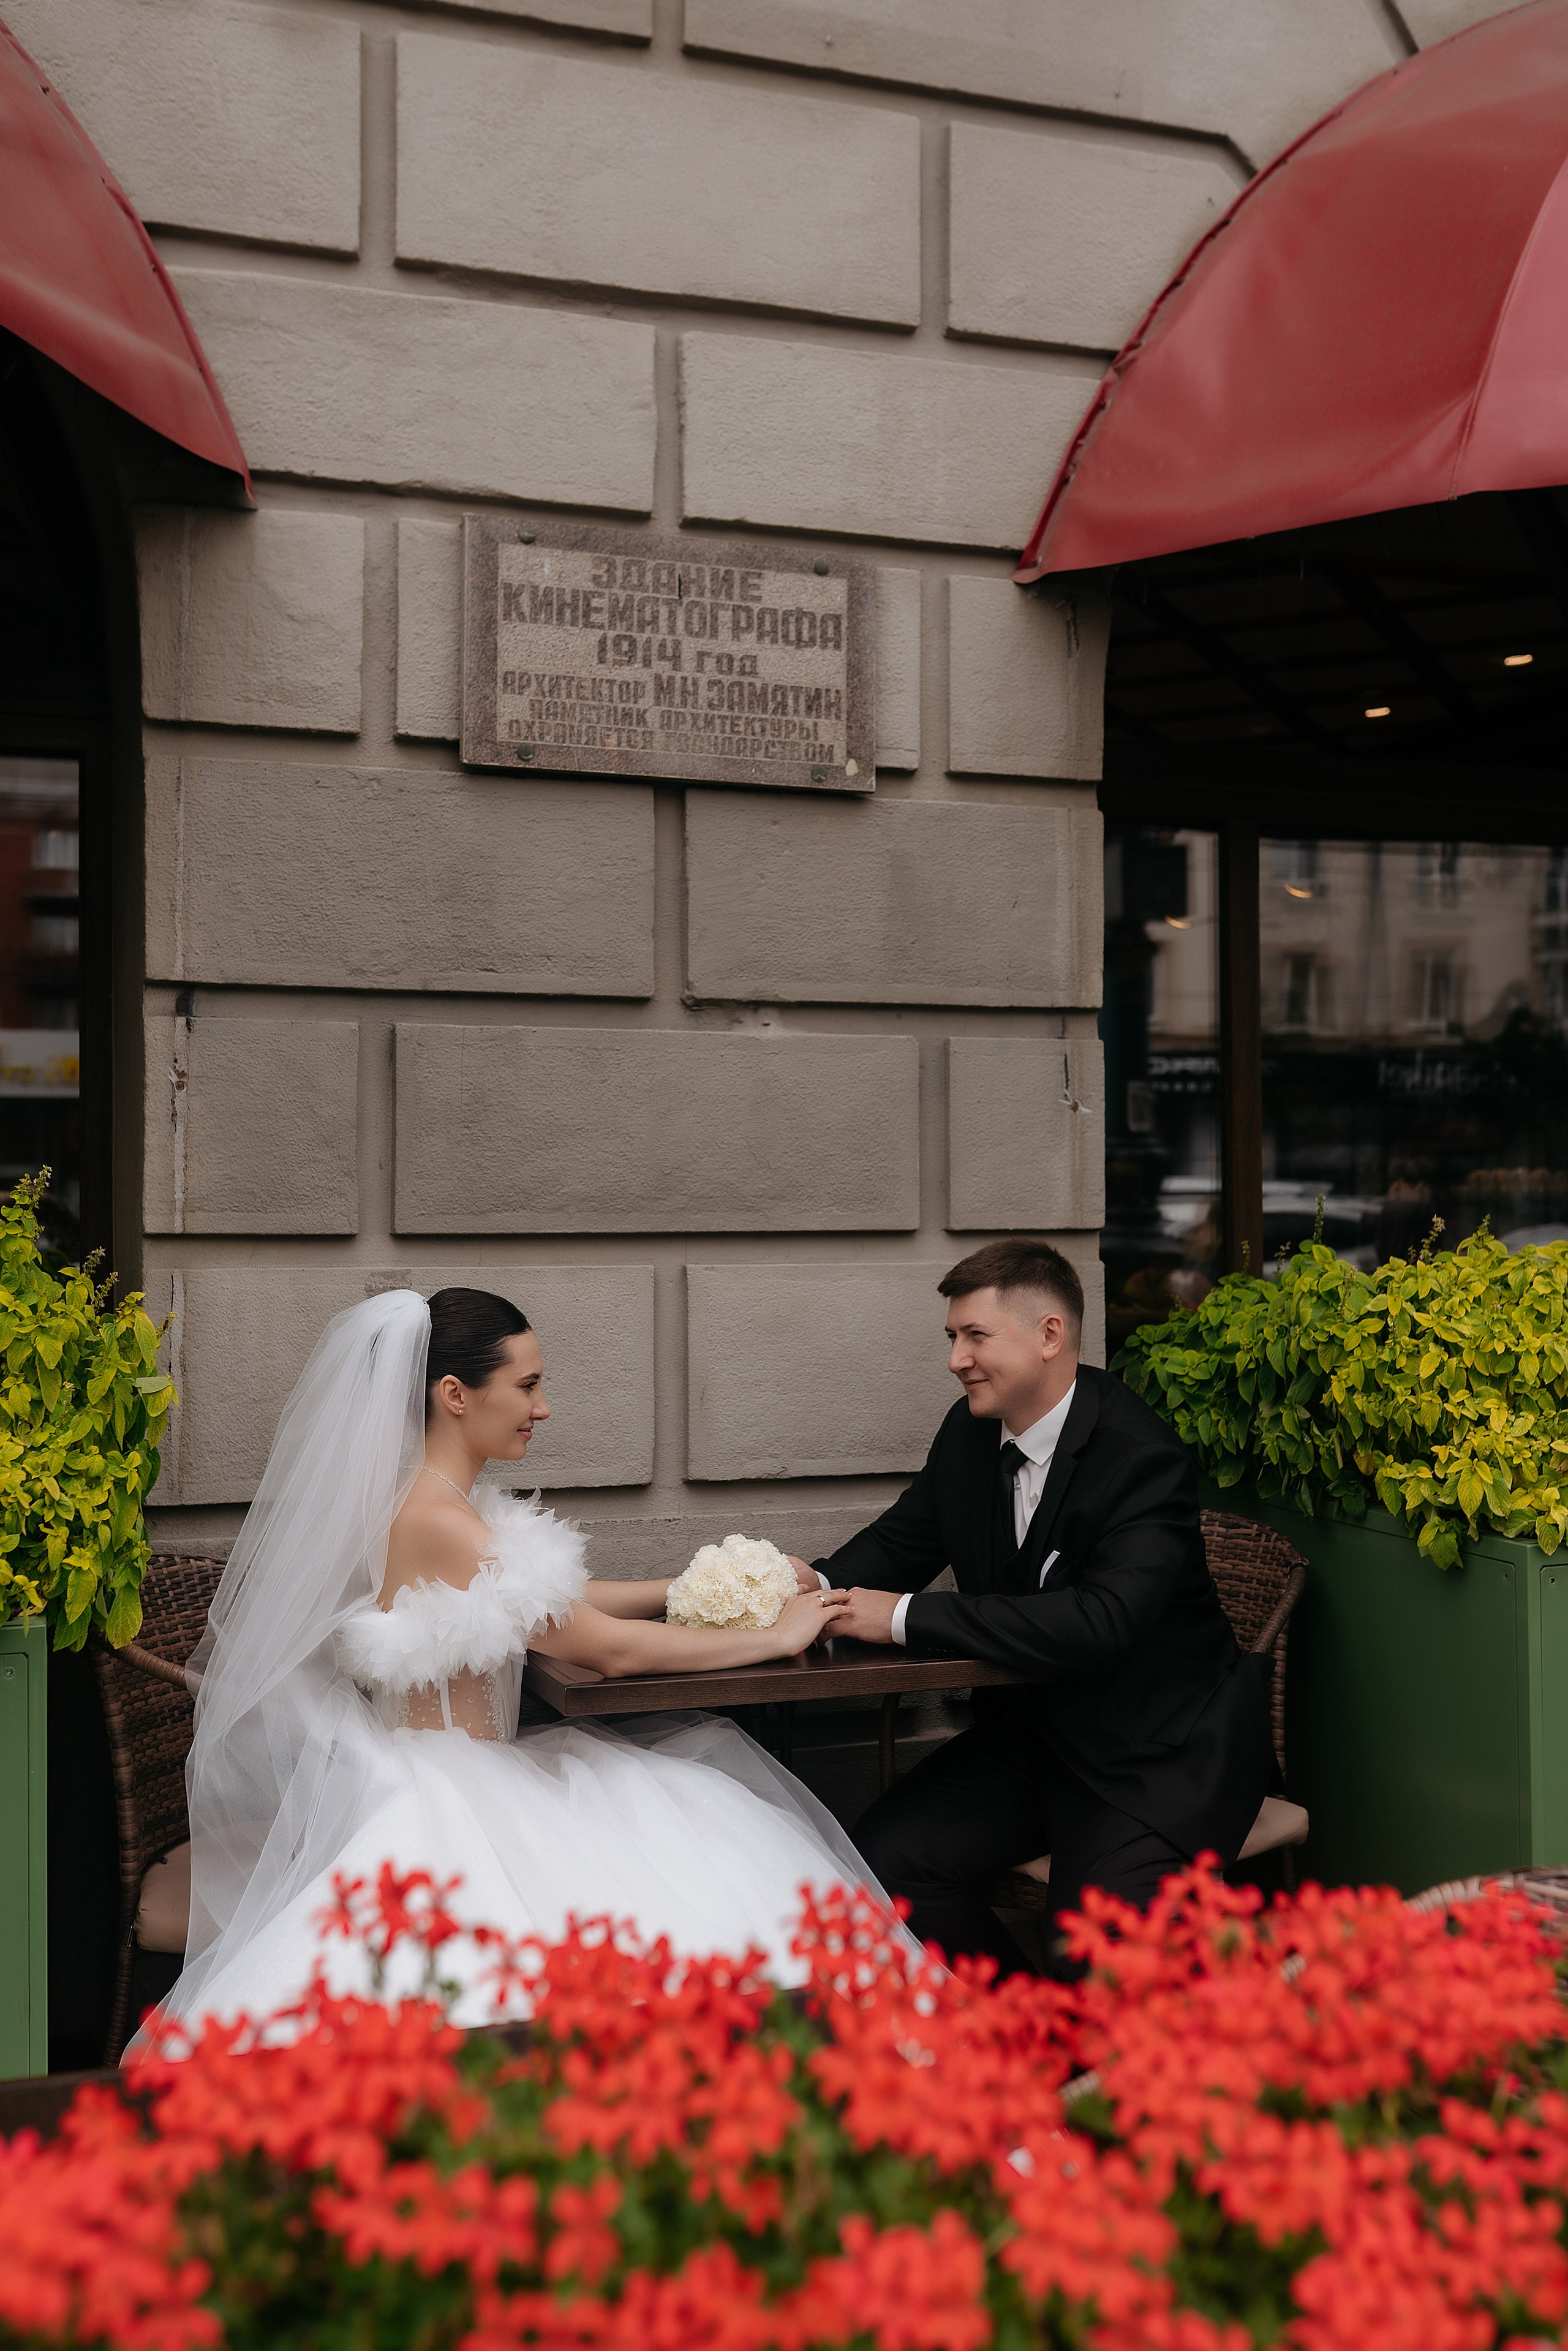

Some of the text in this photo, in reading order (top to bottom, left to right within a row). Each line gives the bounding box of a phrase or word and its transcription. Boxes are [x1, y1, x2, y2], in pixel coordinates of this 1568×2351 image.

[592, 556, 763, 602] ЗДАНИЕ
[502, 582, 842, 651] КИНЕМАТОГРАФА
[597, 632, 682, 671] 1914
[503, 671, 646, 704] АРХИТЕКТОР
[660, 709, 819, 741] АРХИТЕКТУРЫ
